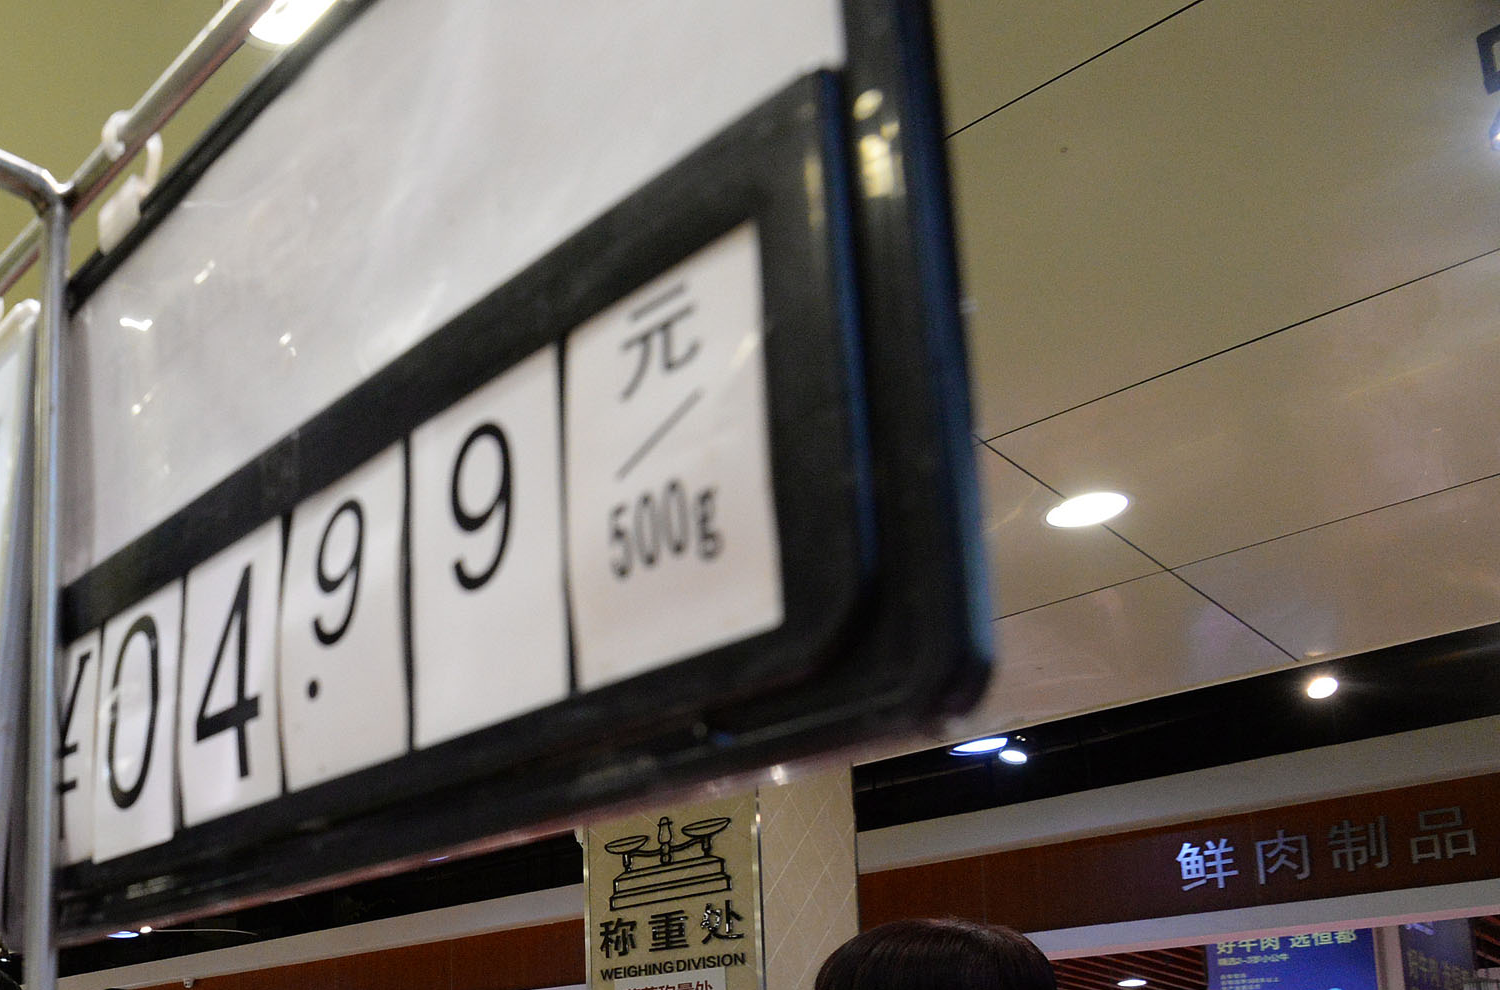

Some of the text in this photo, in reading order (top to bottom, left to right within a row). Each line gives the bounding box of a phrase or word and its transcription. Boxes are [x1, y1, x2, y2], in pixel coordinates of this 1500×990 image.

[620, 285, 702, 401] 元
[609, 477, 723, 582] 500g
[1176, 805, 1477, 892] 鲜肉制品
[599, 899, 745, 959] 称重处
[600, 952, 746, 981] WEIGHING DIVISION
